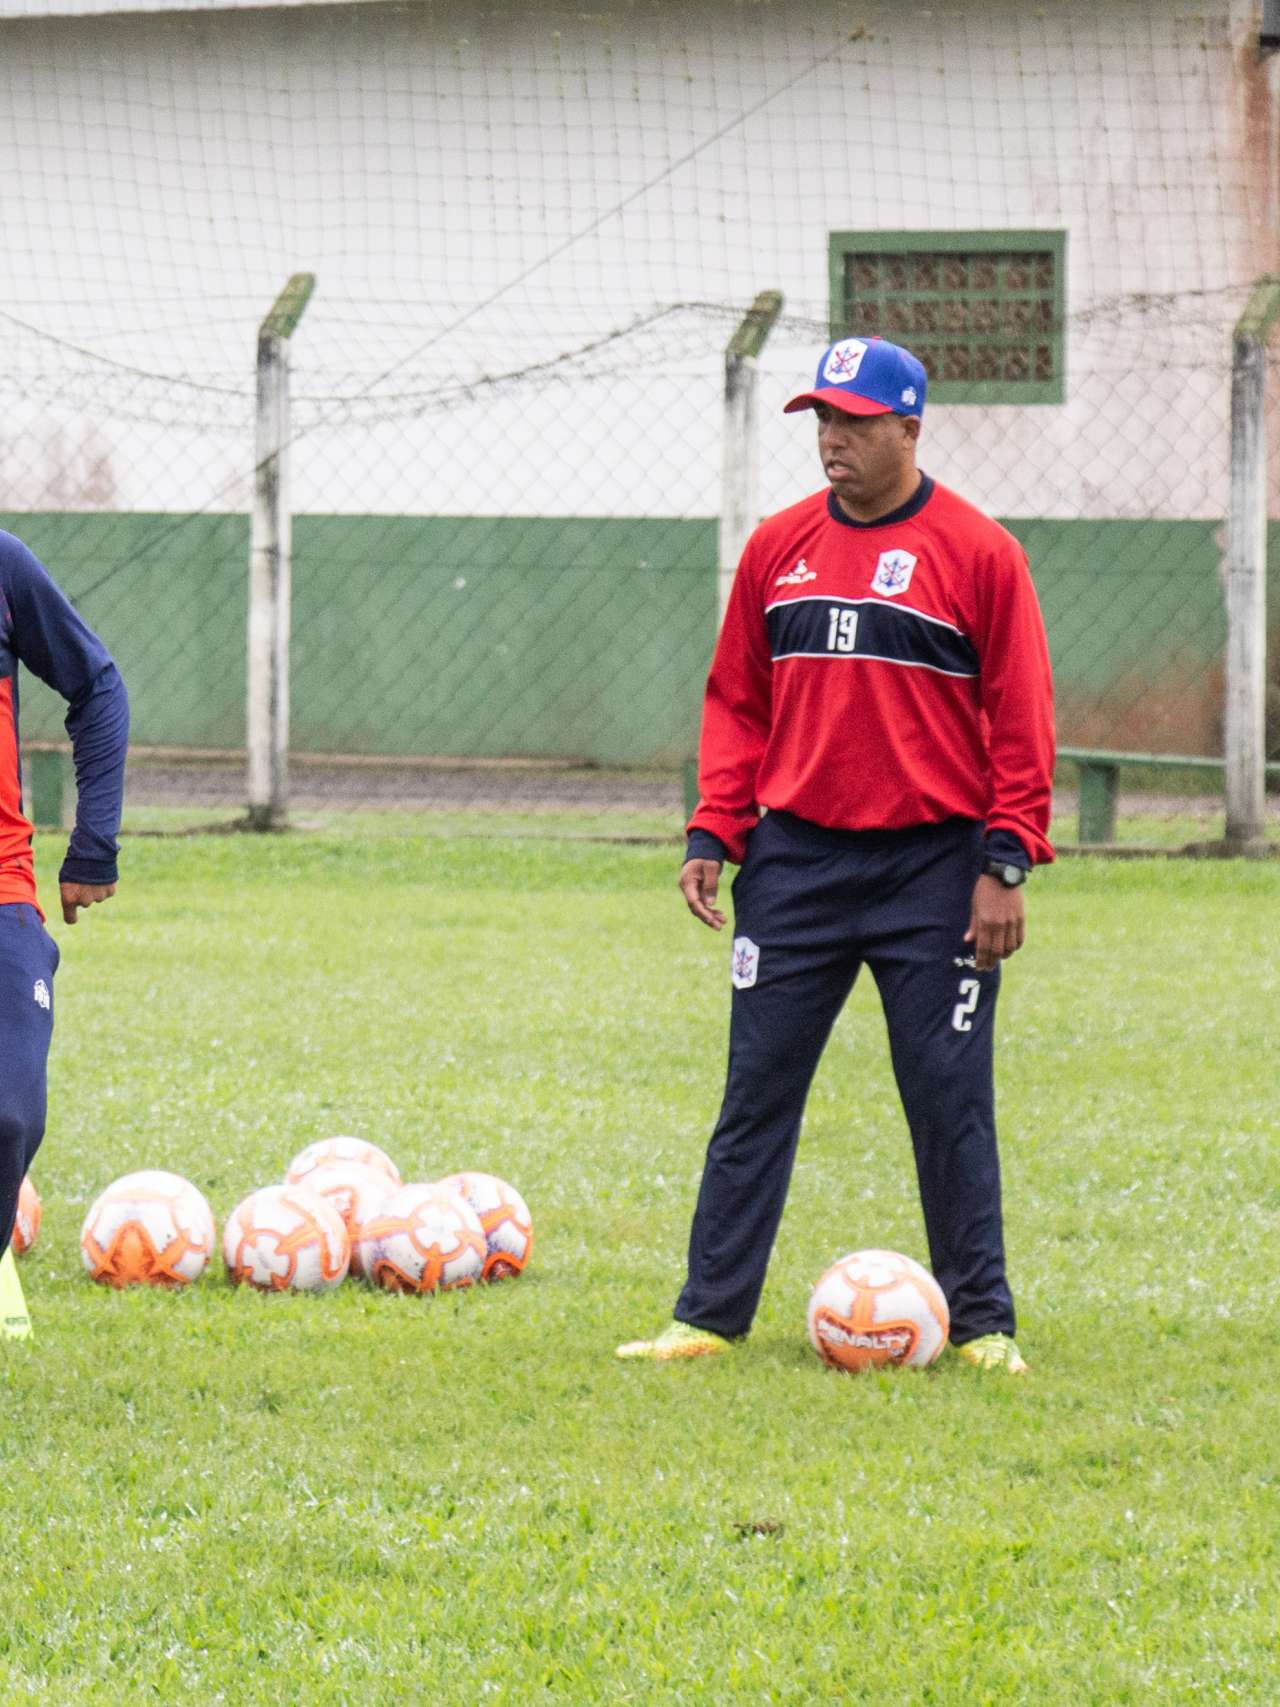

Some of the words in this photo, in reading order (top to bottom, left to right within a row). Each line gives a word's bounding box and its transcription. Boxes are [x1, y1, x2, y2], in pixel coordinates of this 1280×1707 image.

[827, 607, 858, 652] 19
[952, 979, 981, 1031] 2
[817, 1319, 911, 1350] PENALTY
